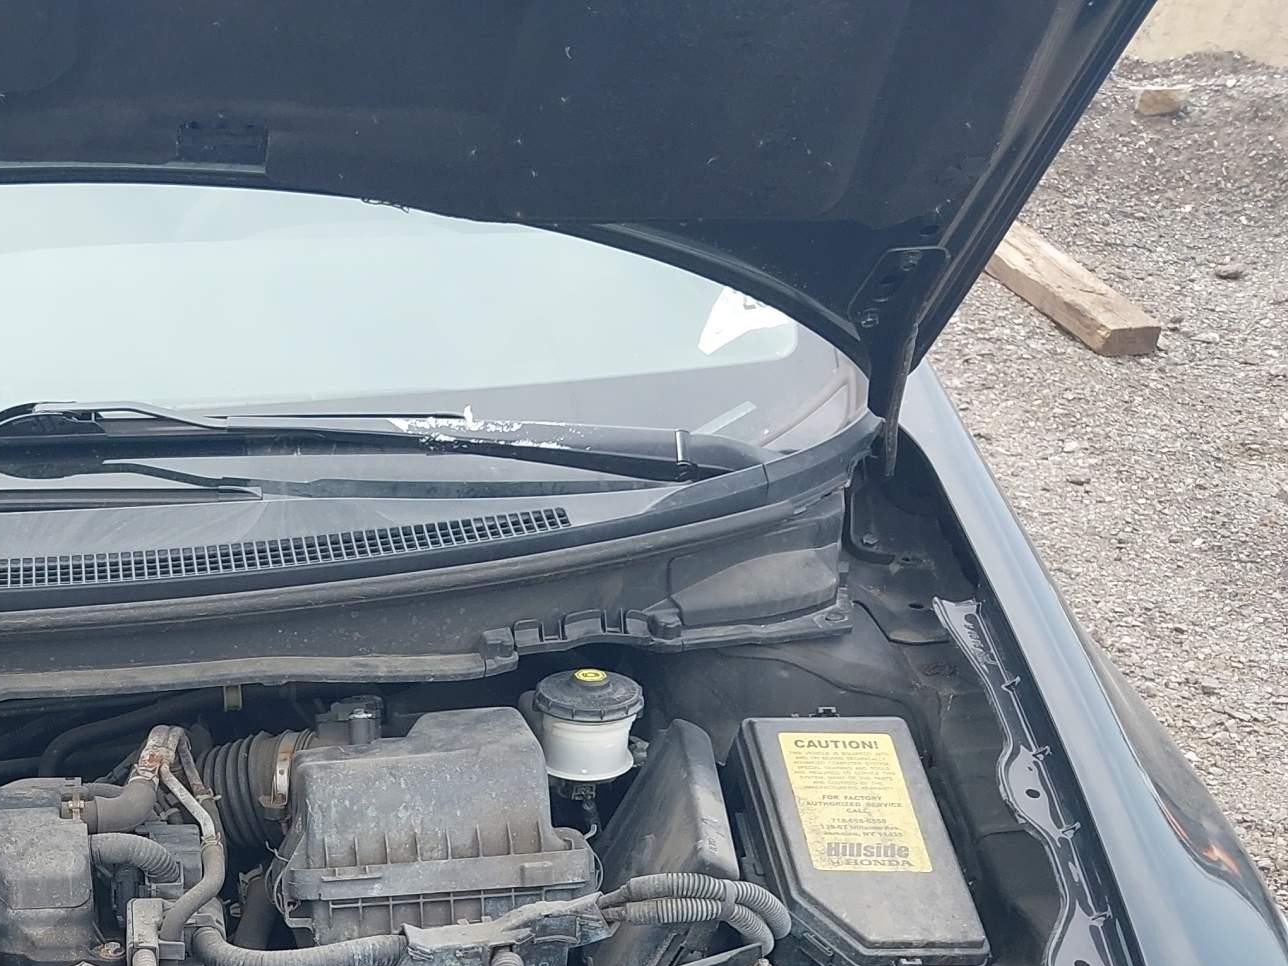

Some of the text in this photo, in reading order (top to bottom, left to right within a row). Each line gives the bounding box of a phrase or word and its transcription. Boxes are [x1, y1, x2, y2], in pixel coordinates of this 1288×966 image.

[794, 739, 879, 750] CAUTION!
[826, 842, 910, 859] Hillside
[844, 859, 915, 867] HONDA
